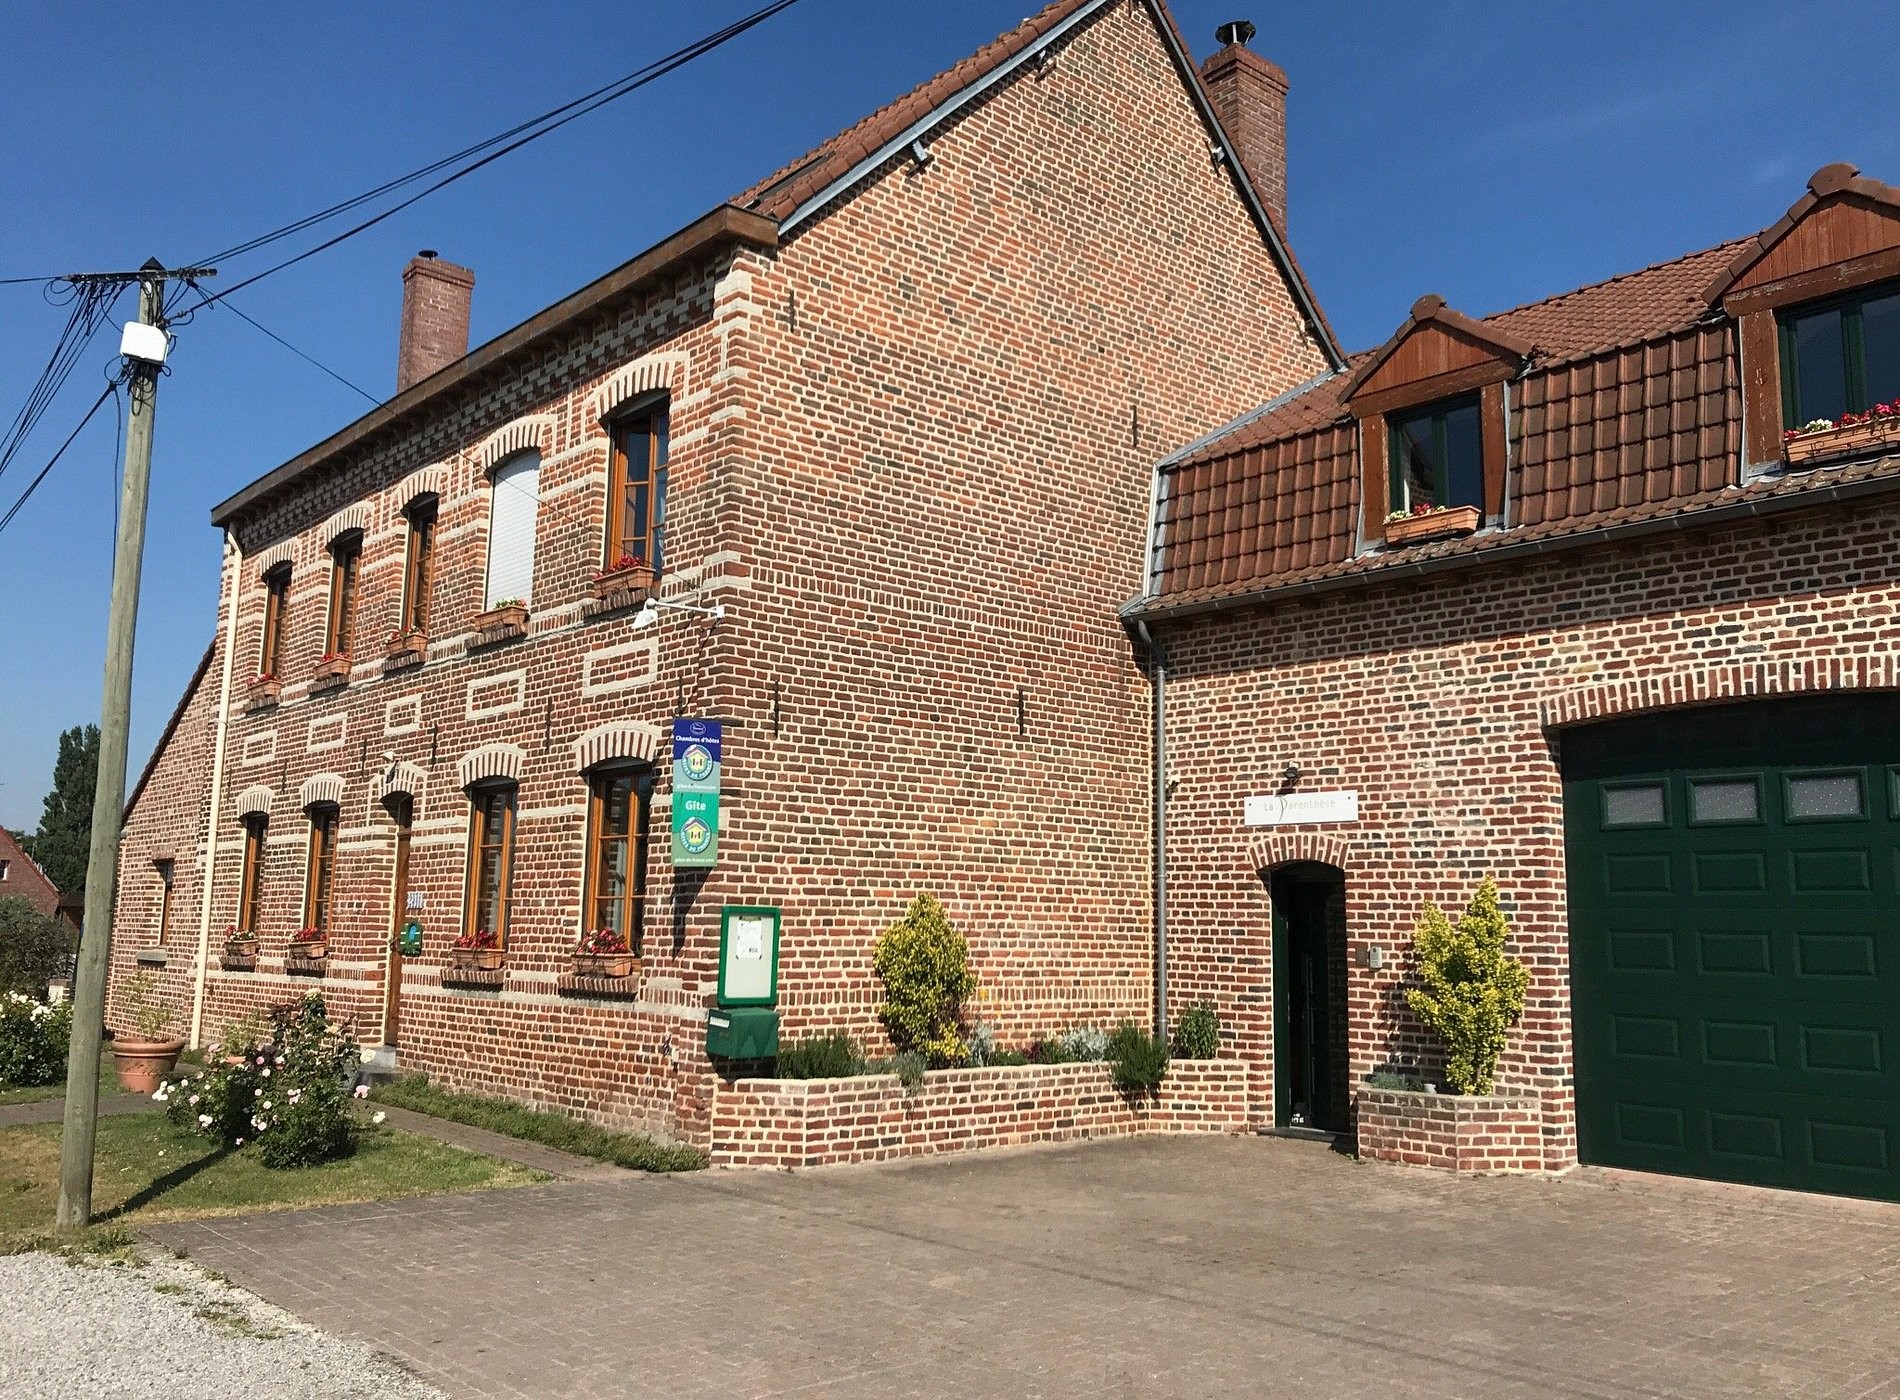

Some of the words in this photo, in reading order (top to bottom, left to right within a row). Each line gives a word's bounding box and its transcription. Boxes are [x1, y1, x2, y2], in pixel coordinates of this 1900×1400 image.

[675, 735, 700, 743] Chambres
[701, 736, 720, 744] d'hôtes
[1263, 801, 1274, 811] La
[1278, 797, 1336, 822] Parenthèse
